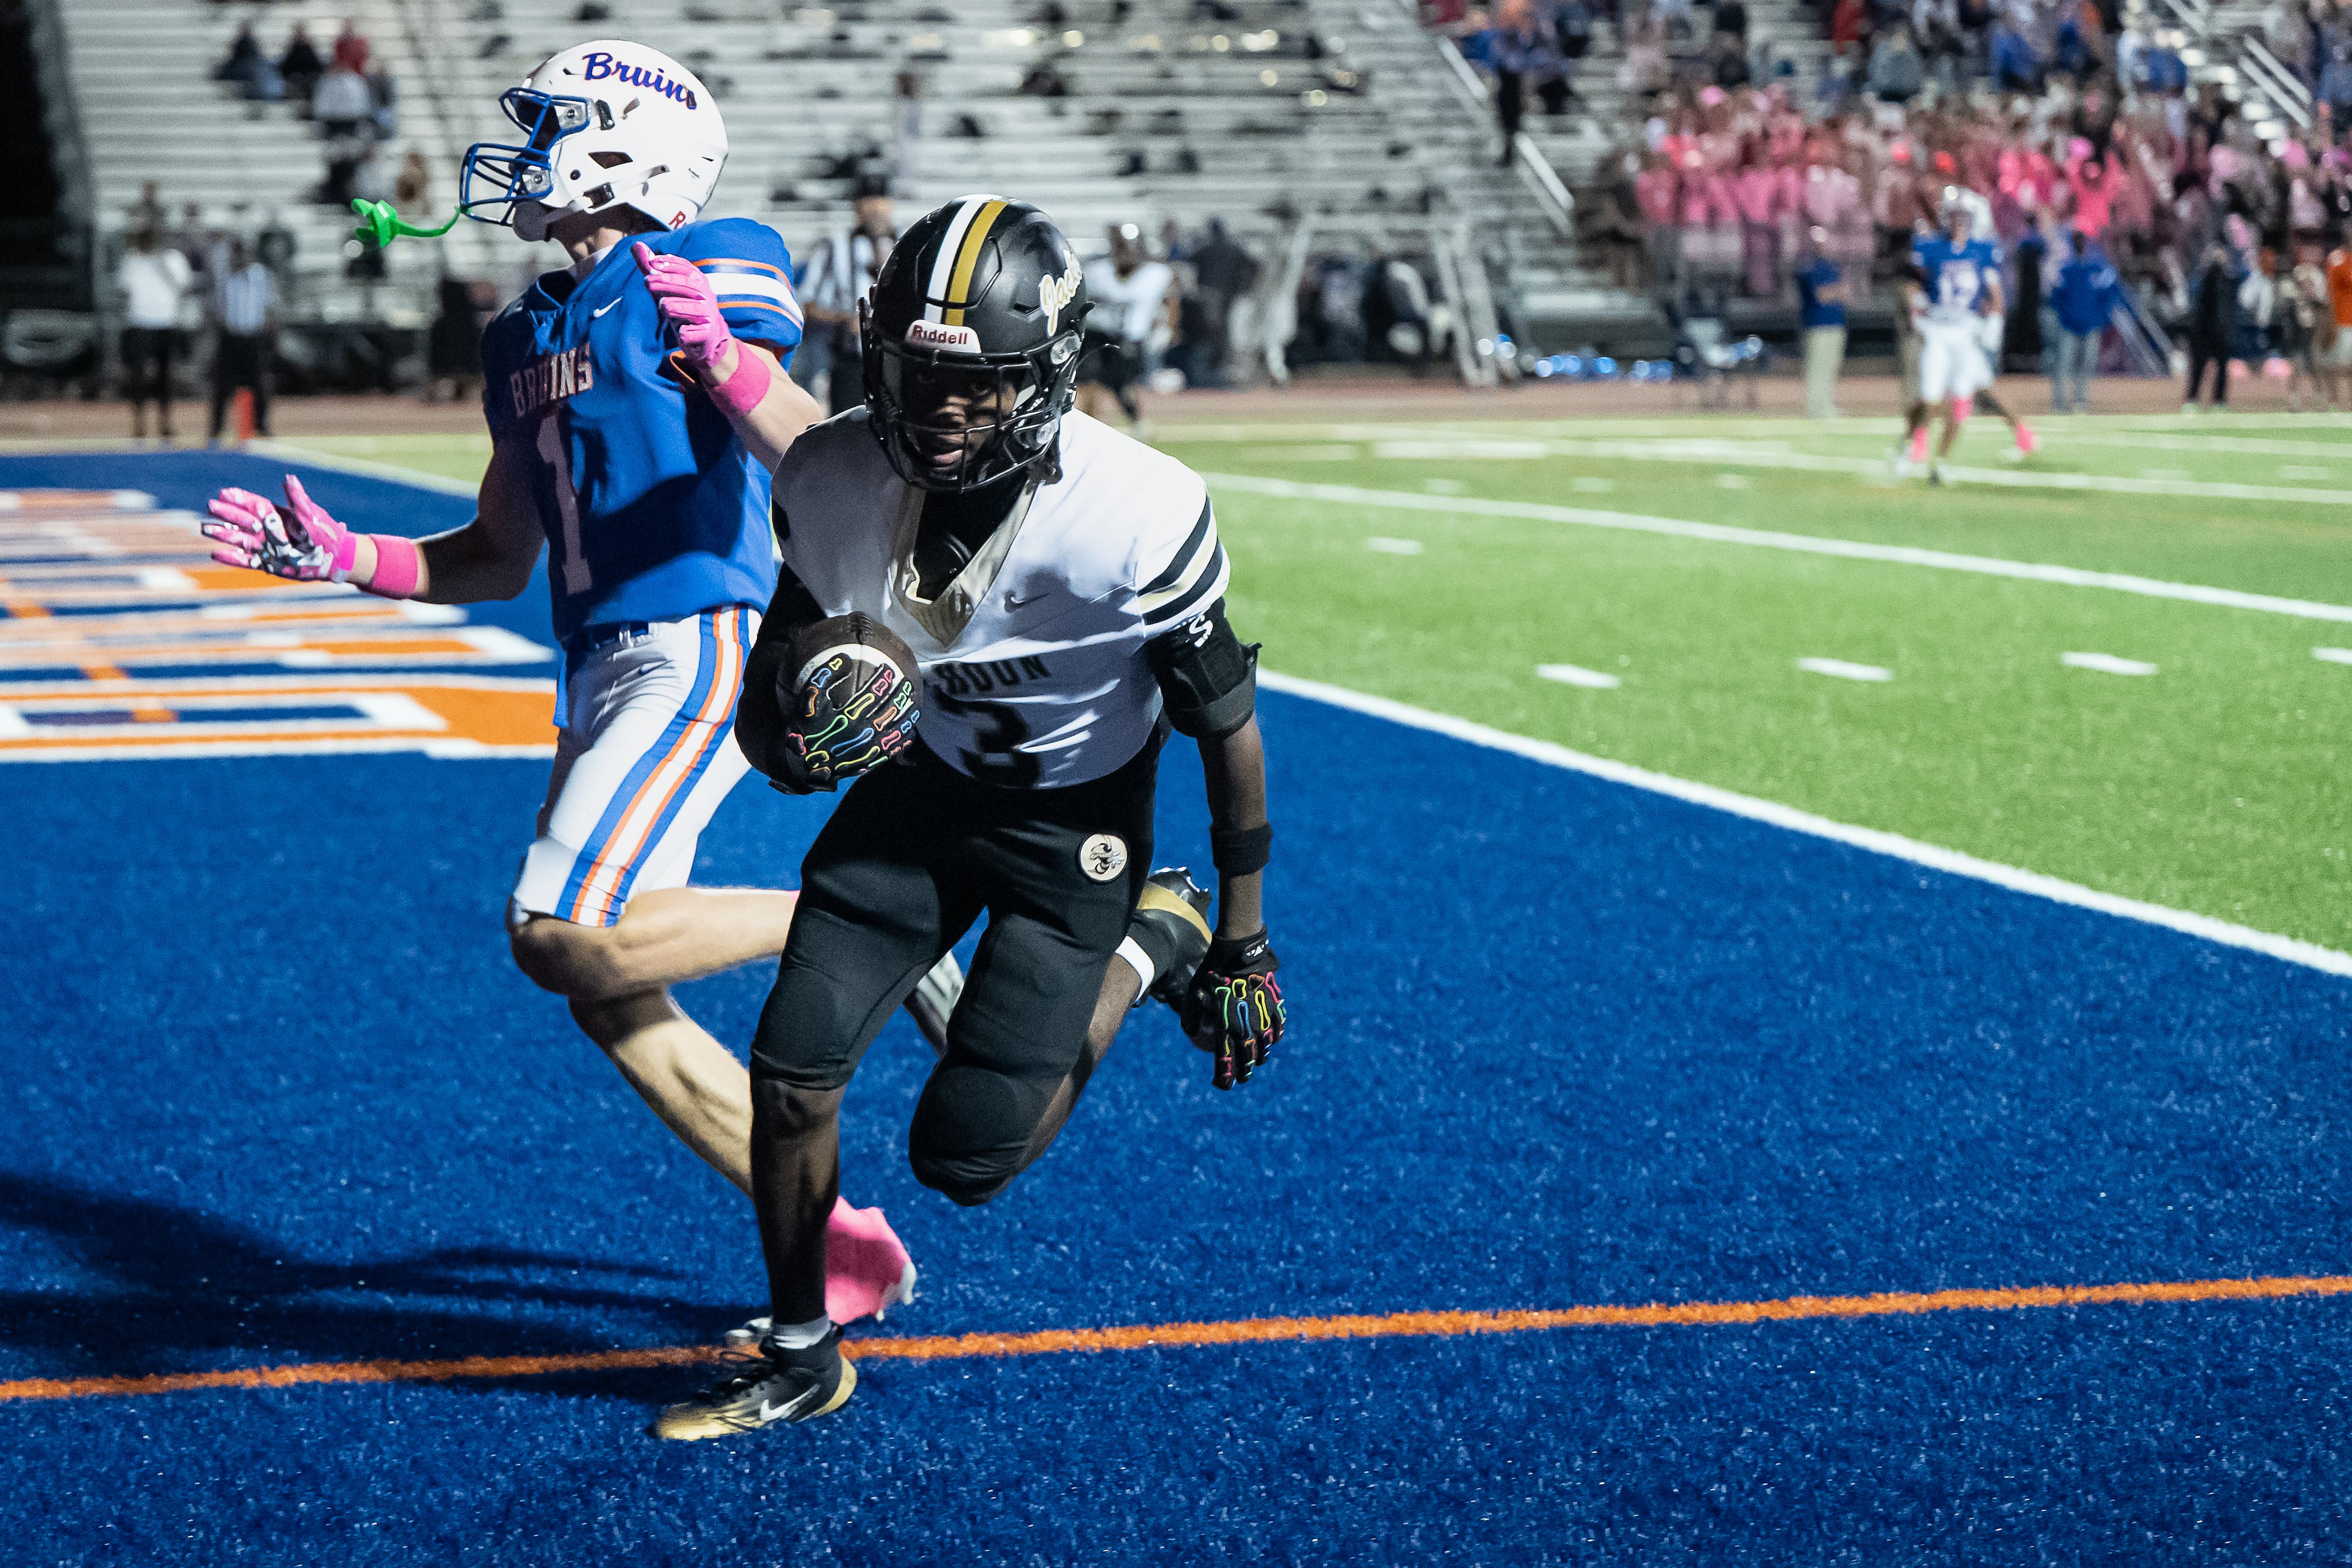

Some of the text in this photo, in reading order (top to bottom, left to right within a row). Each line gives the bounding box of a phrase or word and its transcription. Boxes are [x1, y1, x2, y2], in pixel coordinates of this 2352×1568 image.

[911, 325, 968, 345] Riddell
[510, 342, 594, 418] BRUINS
[537, 414, 593, 595] 1
